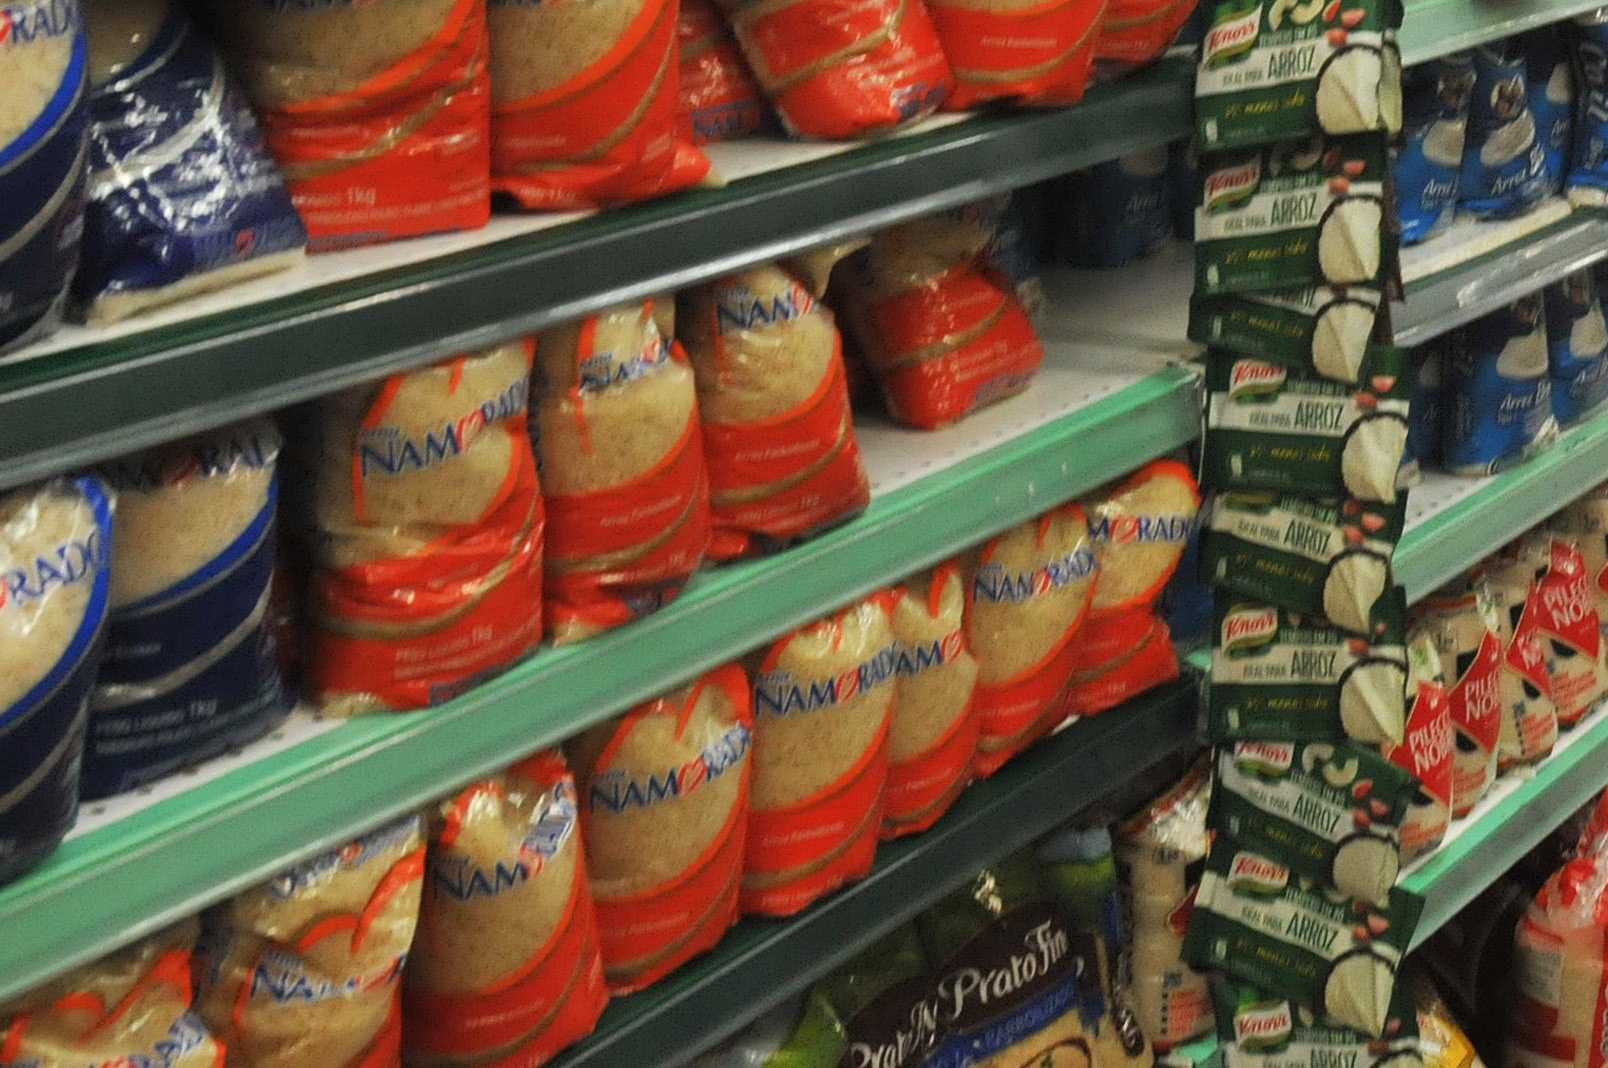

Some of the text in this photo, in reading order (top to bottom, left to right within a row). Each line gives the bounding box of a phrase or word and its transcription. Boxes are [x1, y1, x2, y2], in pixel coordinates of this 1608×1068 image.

[1267, 43, 1317, 80] ARROZ
[1271, 191, 1318, 226] ARROZ
[1294, 400, 1344, 431] ARROZ
[1284, 519, 1332, 557] ARROZ
[1225, 612, 1275, 640] Knorr
[1290, 649, 1336, 679] ARROZ
[1292, 793, 1341, 834] ARROZ
[1235, 853, 1288, 881] Knorr
[1286, 911, 1339, 952] ARROZ
[938, 949, 1037, 1020] Prato
